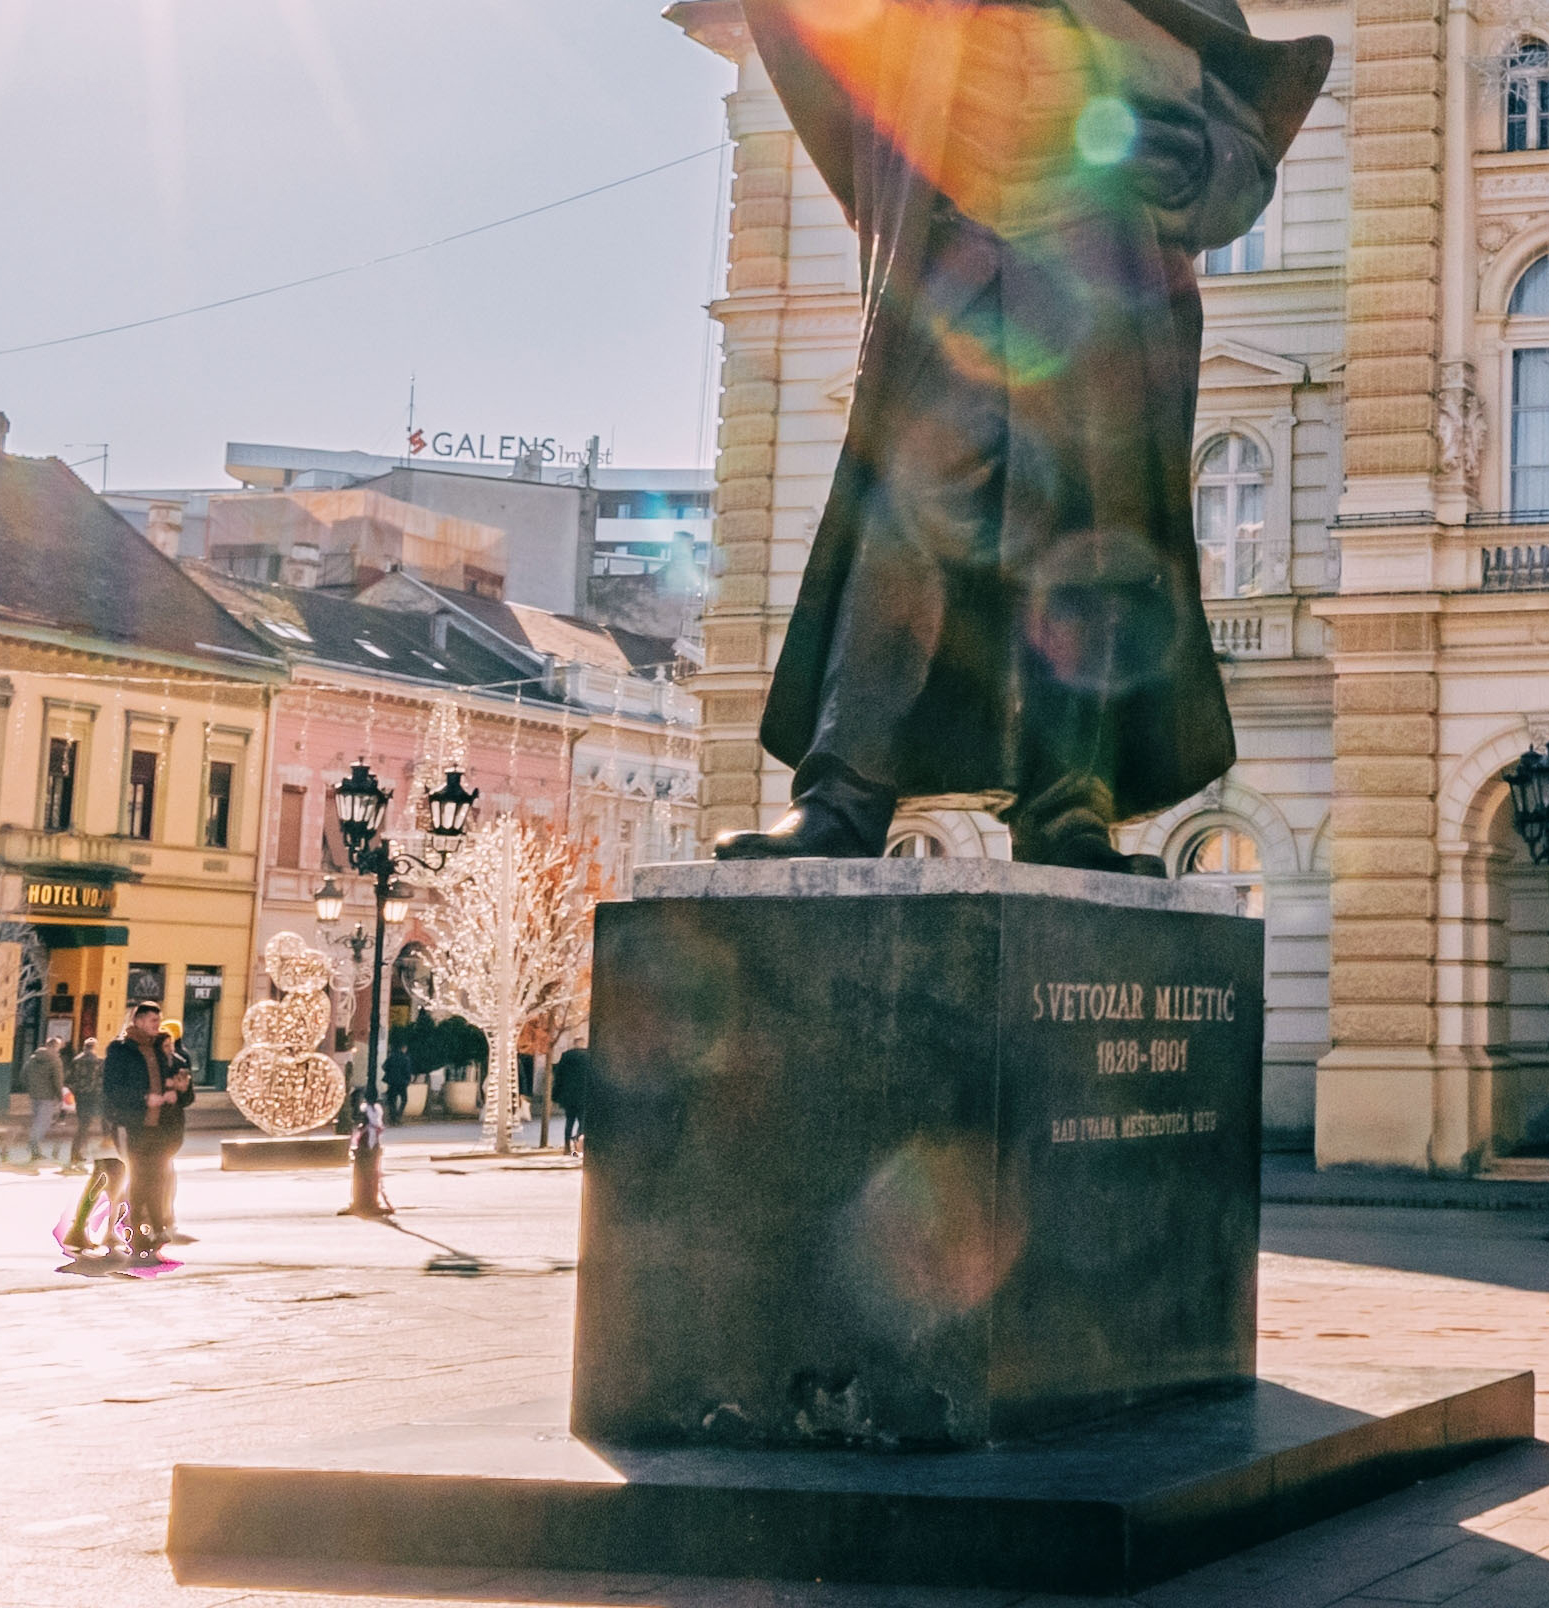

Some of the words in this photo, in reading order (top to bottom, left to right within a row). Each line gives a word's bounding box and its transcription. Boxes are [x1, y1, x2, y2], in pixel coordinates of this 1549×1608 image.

[432, 432, 555, 462] GALENS
[28, 884, 78, 905] HOTEL
[1034, 983, 1144, 1021] SVETOZAR
[1155, 983, 1235, 1022] MILETIĆ
